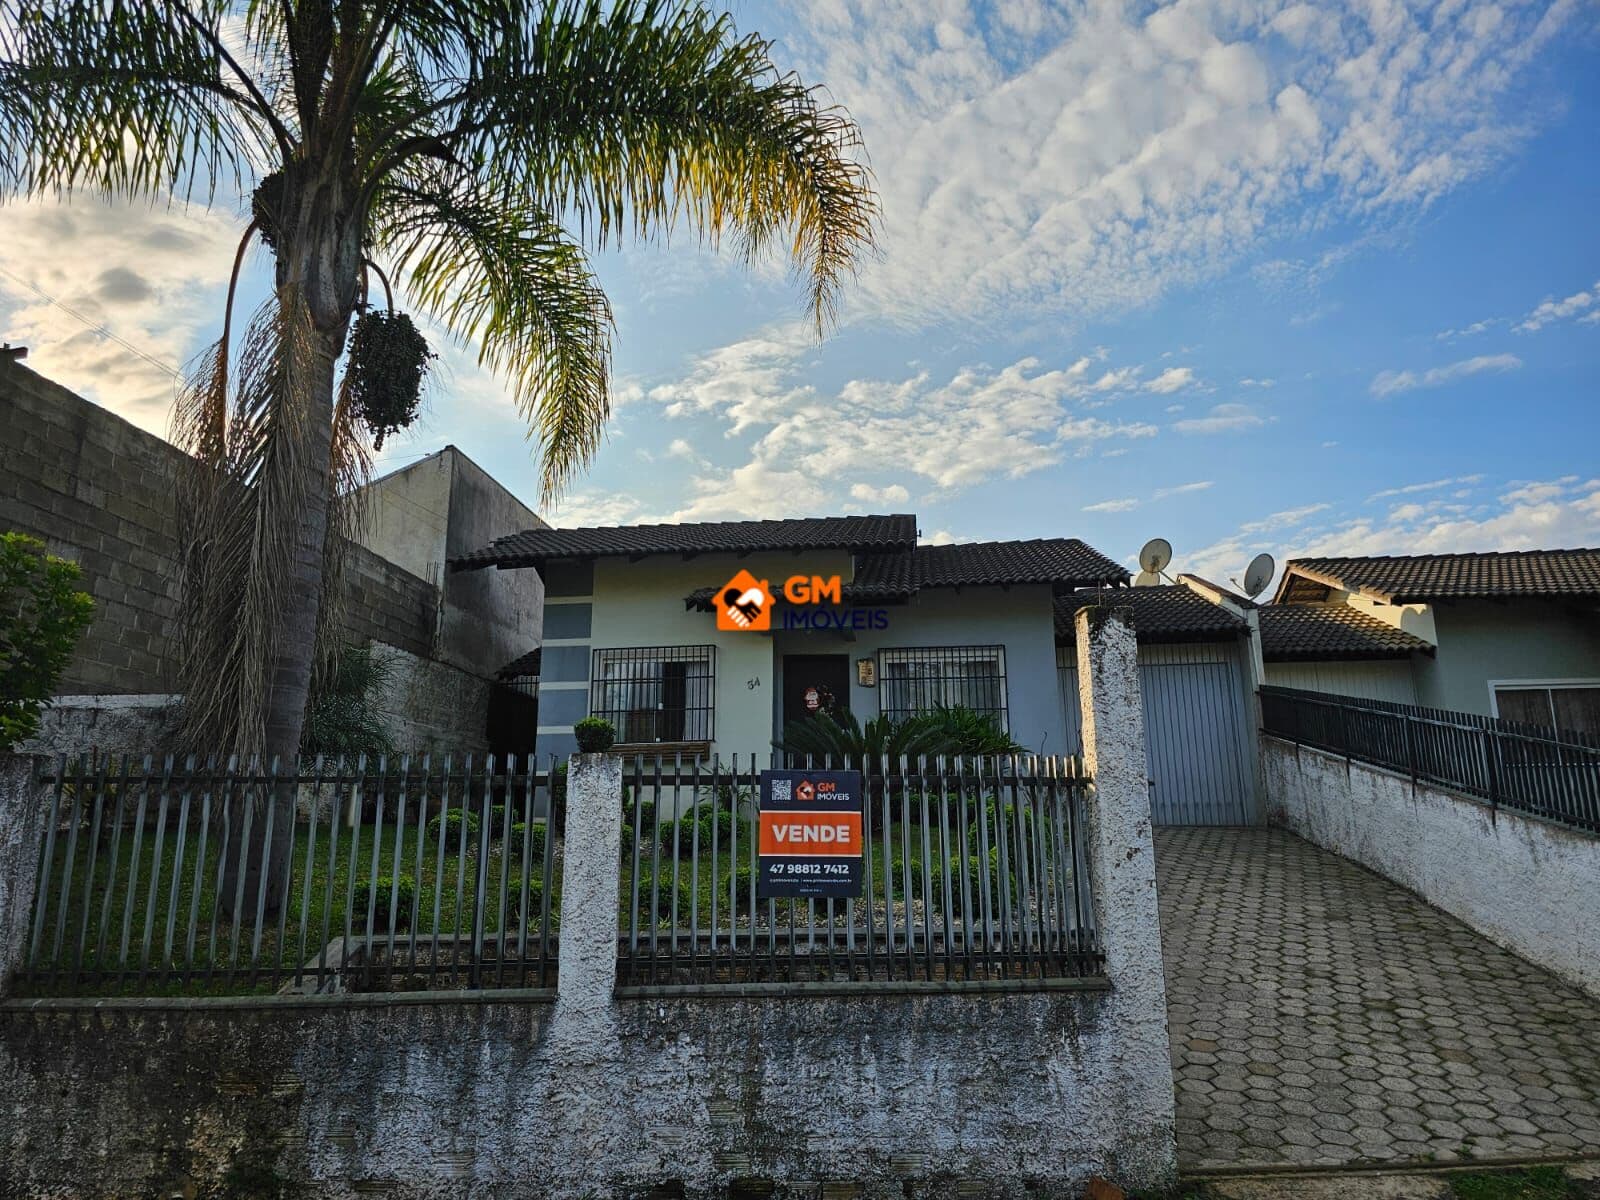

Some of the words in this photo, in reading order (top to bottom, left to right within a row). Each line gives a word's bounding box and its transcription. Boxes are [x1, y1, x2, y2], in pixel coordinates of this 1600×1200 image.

[817, 783, 835, 792] GM
[817, 792, 850, 801] IMÓVEIS
[772, 825, 850, 842] VENDE
[769, 864, 784, 874] 47
[787, 864, 821, 874] 98812
[823, 864, 849, 874] 7412
